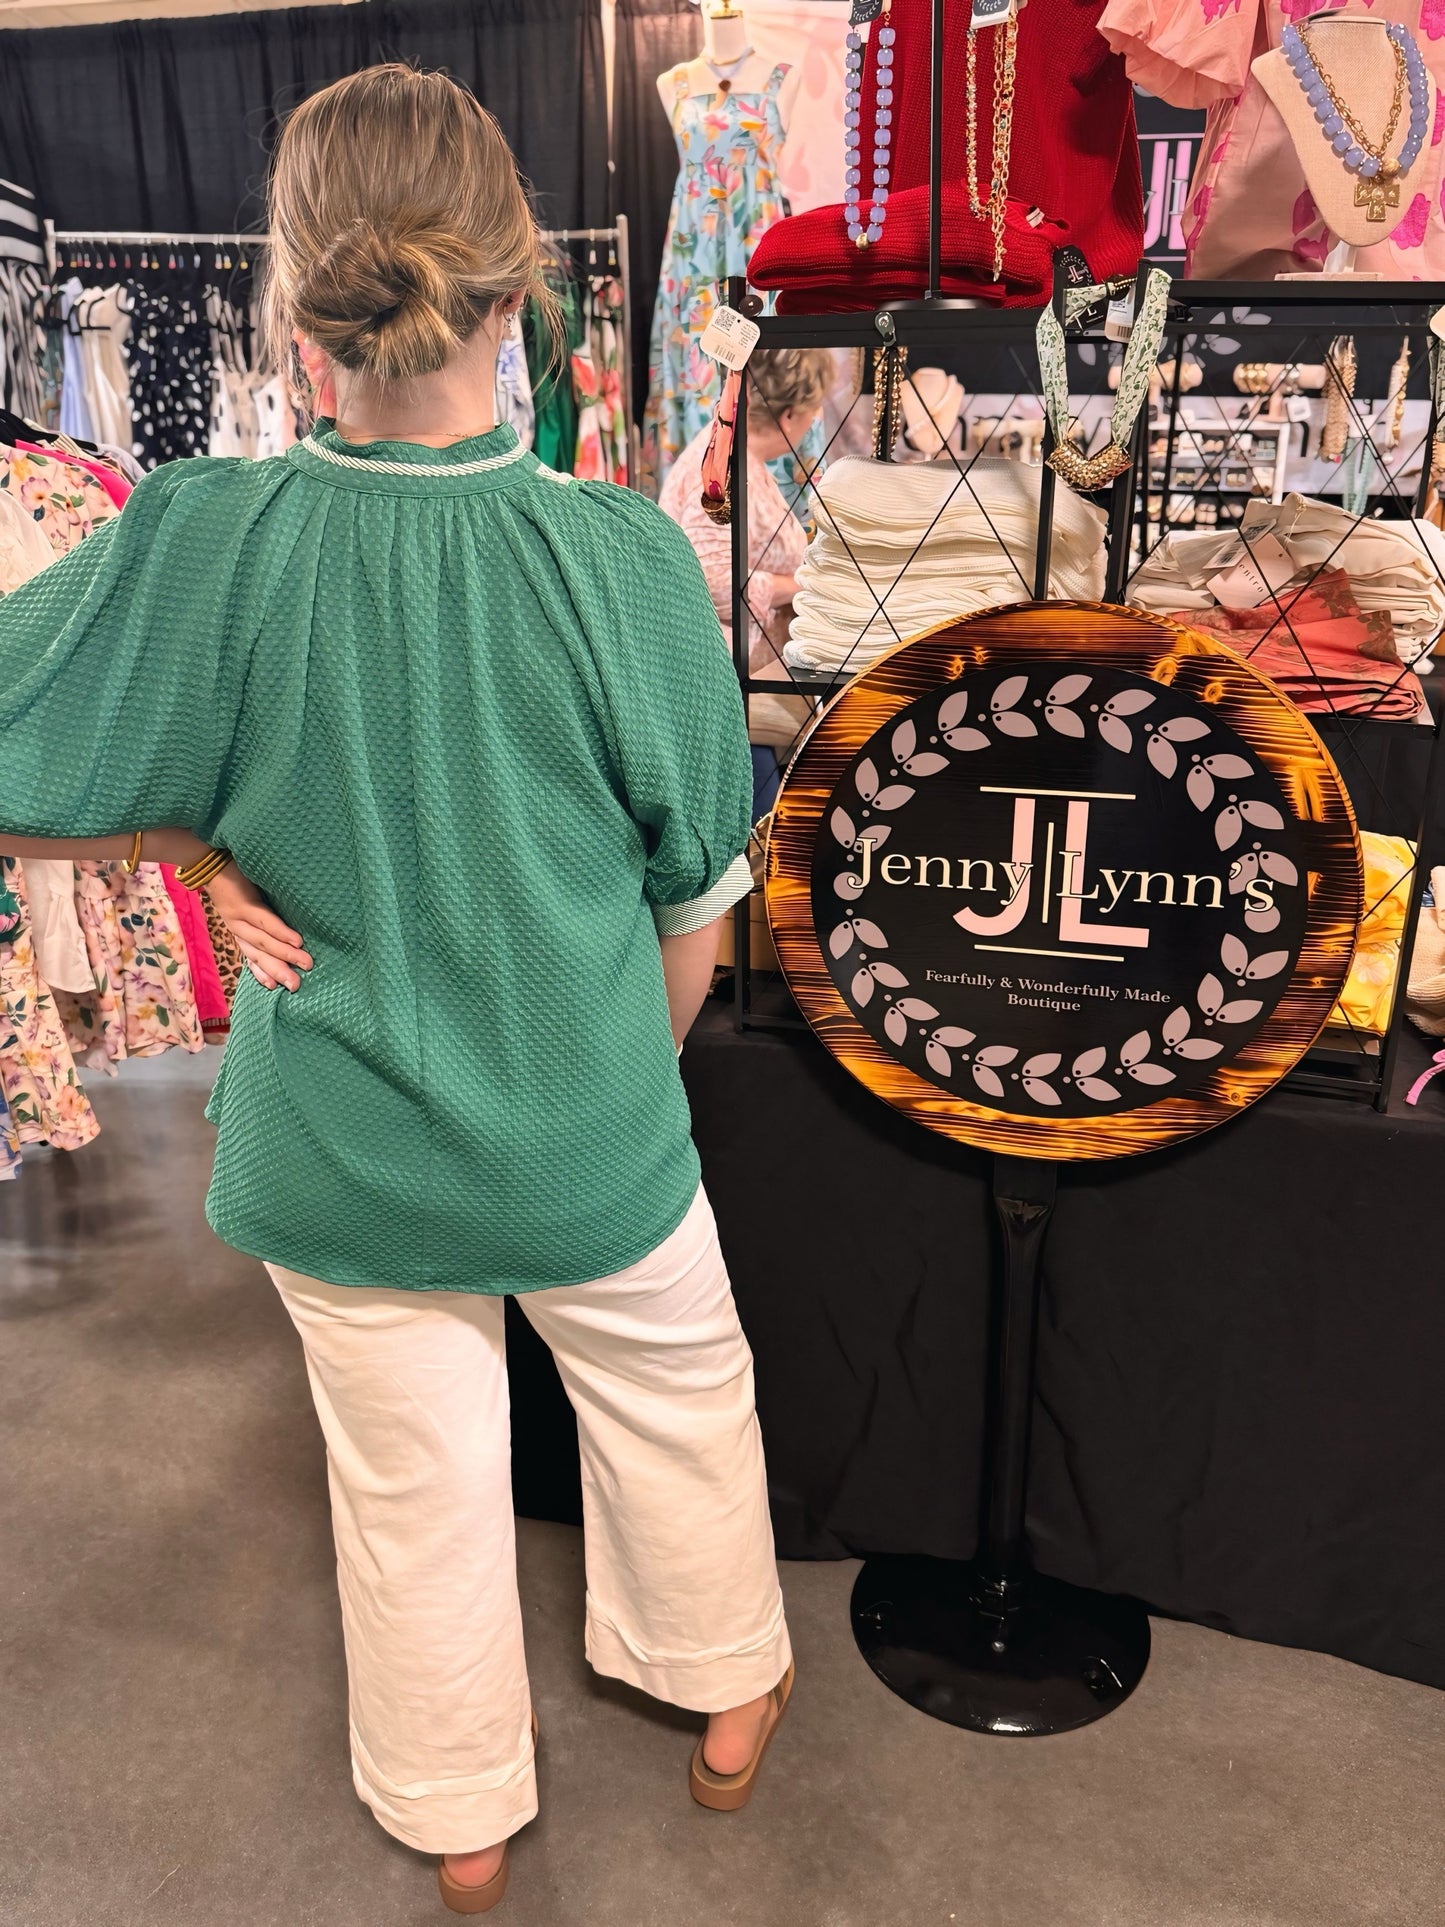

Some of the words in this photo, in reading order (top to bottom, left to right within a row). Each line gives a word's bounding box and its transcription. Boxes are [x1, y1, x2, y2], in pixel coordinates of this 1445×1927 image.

[847, 837, 1034, 906] Jenny
[925, 969, 996, 989] Fearfully
[1000, 976, 1014, 989] &
[1018, 978, 1120, 1001] Wonderfully
[1124, 988, 1171, 1003] Made
[1007, 993, 1081, 1012] Boutique
